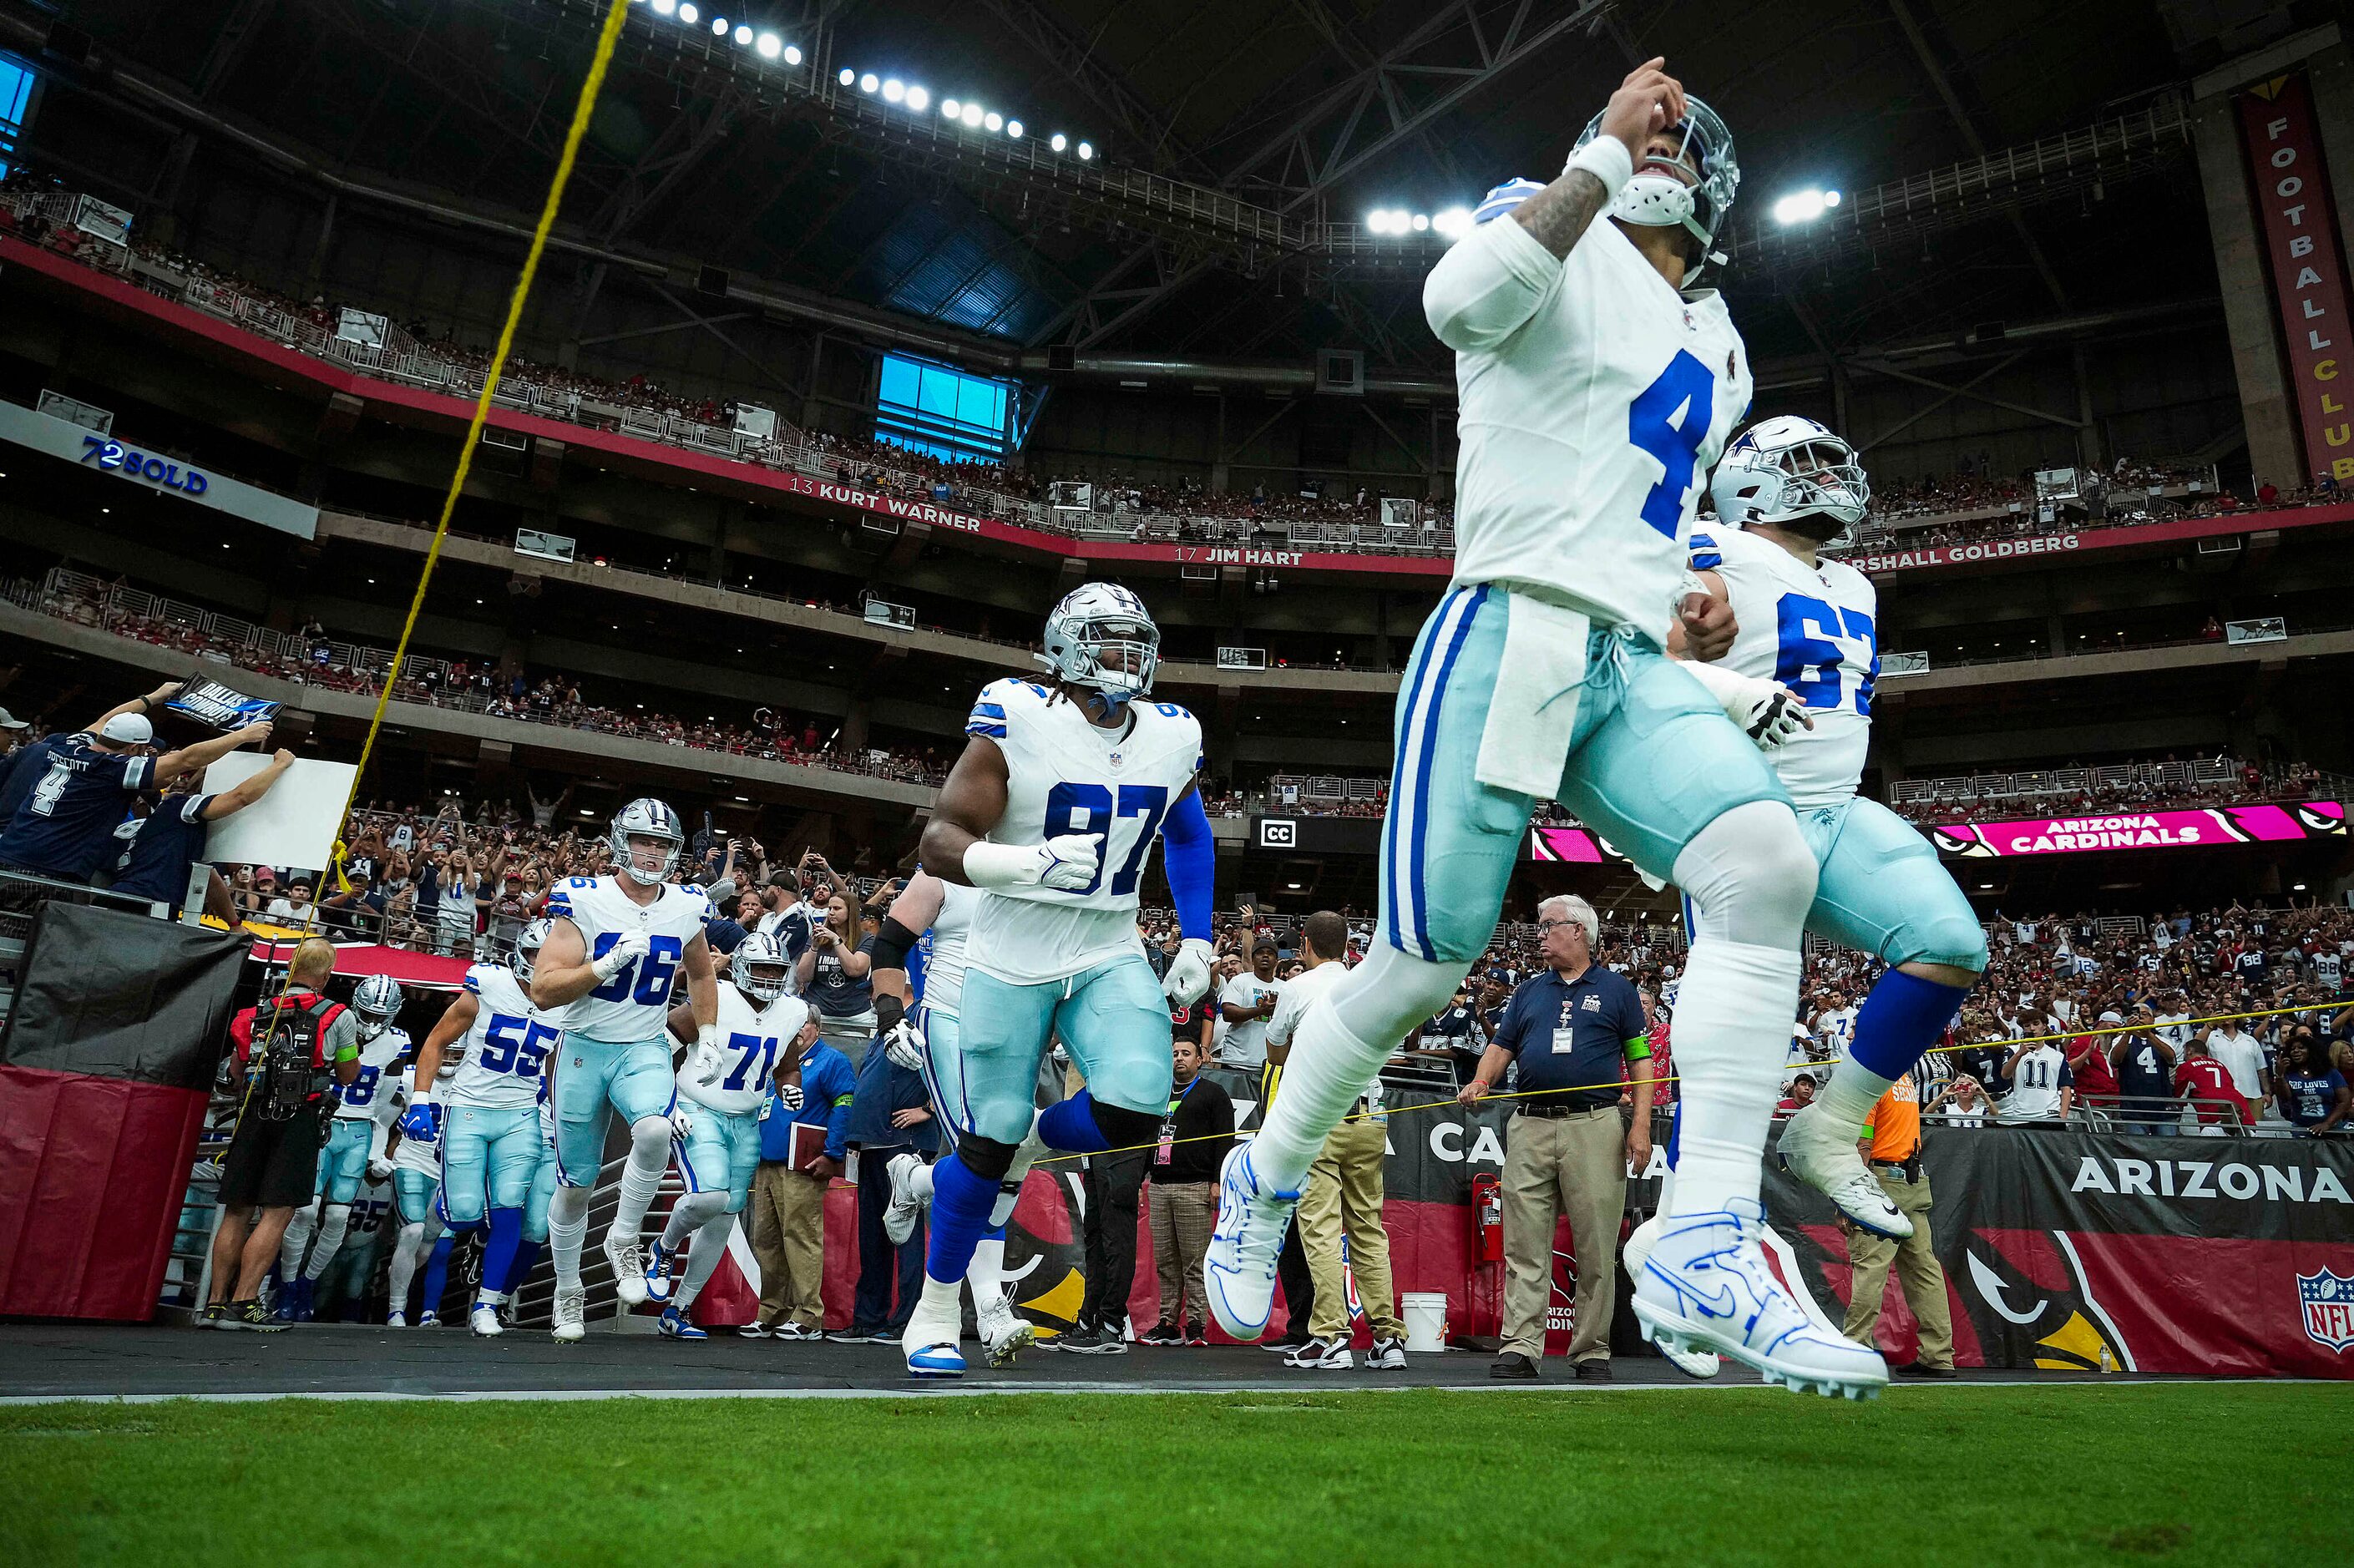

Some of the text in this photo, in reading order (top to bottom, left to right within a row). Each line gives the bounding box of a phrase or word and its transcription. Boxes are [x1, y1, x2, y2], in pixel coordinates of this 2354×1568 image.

[2266, 116, 2354, 481] FOOTBALL CLUB
[1629, 348, 1715, 541] 4
[789, 477, 980, 532] 13 KURT WARNER
[1174, 548, 1303, 565] 17 JIM HART
[1840, 534, 2080, 572] RSHALL GOLDBERG
[1774, 593, 1881, 716] 67
[178, 692, 240, 721] COWBOYS
[197, 682, 249, 709] DALLAS
[31, 763, 72, 817] 4
[398, 829, 408, 840] 8
[1043, 781, 1168, 896] 97
[1267, 827, 1290, 841] CC
[2046, 816, 2161, 834] ARIZONA
[2011, 827, 2201, 852] CARDINALS
[2157, 927, 2167, 938] 11
[2244, 954, 2262, 967] 88
[2318, 961, 2338, 974] 88
[1837, 1019, 1847, 1036] 7
[2170, 1025, 2181, 1042] 4
[479, 1013, 560, 1077] 55
[722, 1032, 778, 1092] 71
[1978, 1060, 1994, 1084] 7
[2136, 1046, 2158, 1074] 4
[2023, 1059, 2050, 1090] 11
[2205, 1067, 2221, 1088] 7
[2304, 1080, 2329, 1089] LOVES
[2070, 1156, 2354, 1203] ARIZONA
[2308, 1303, 2354, 1341] NFL
